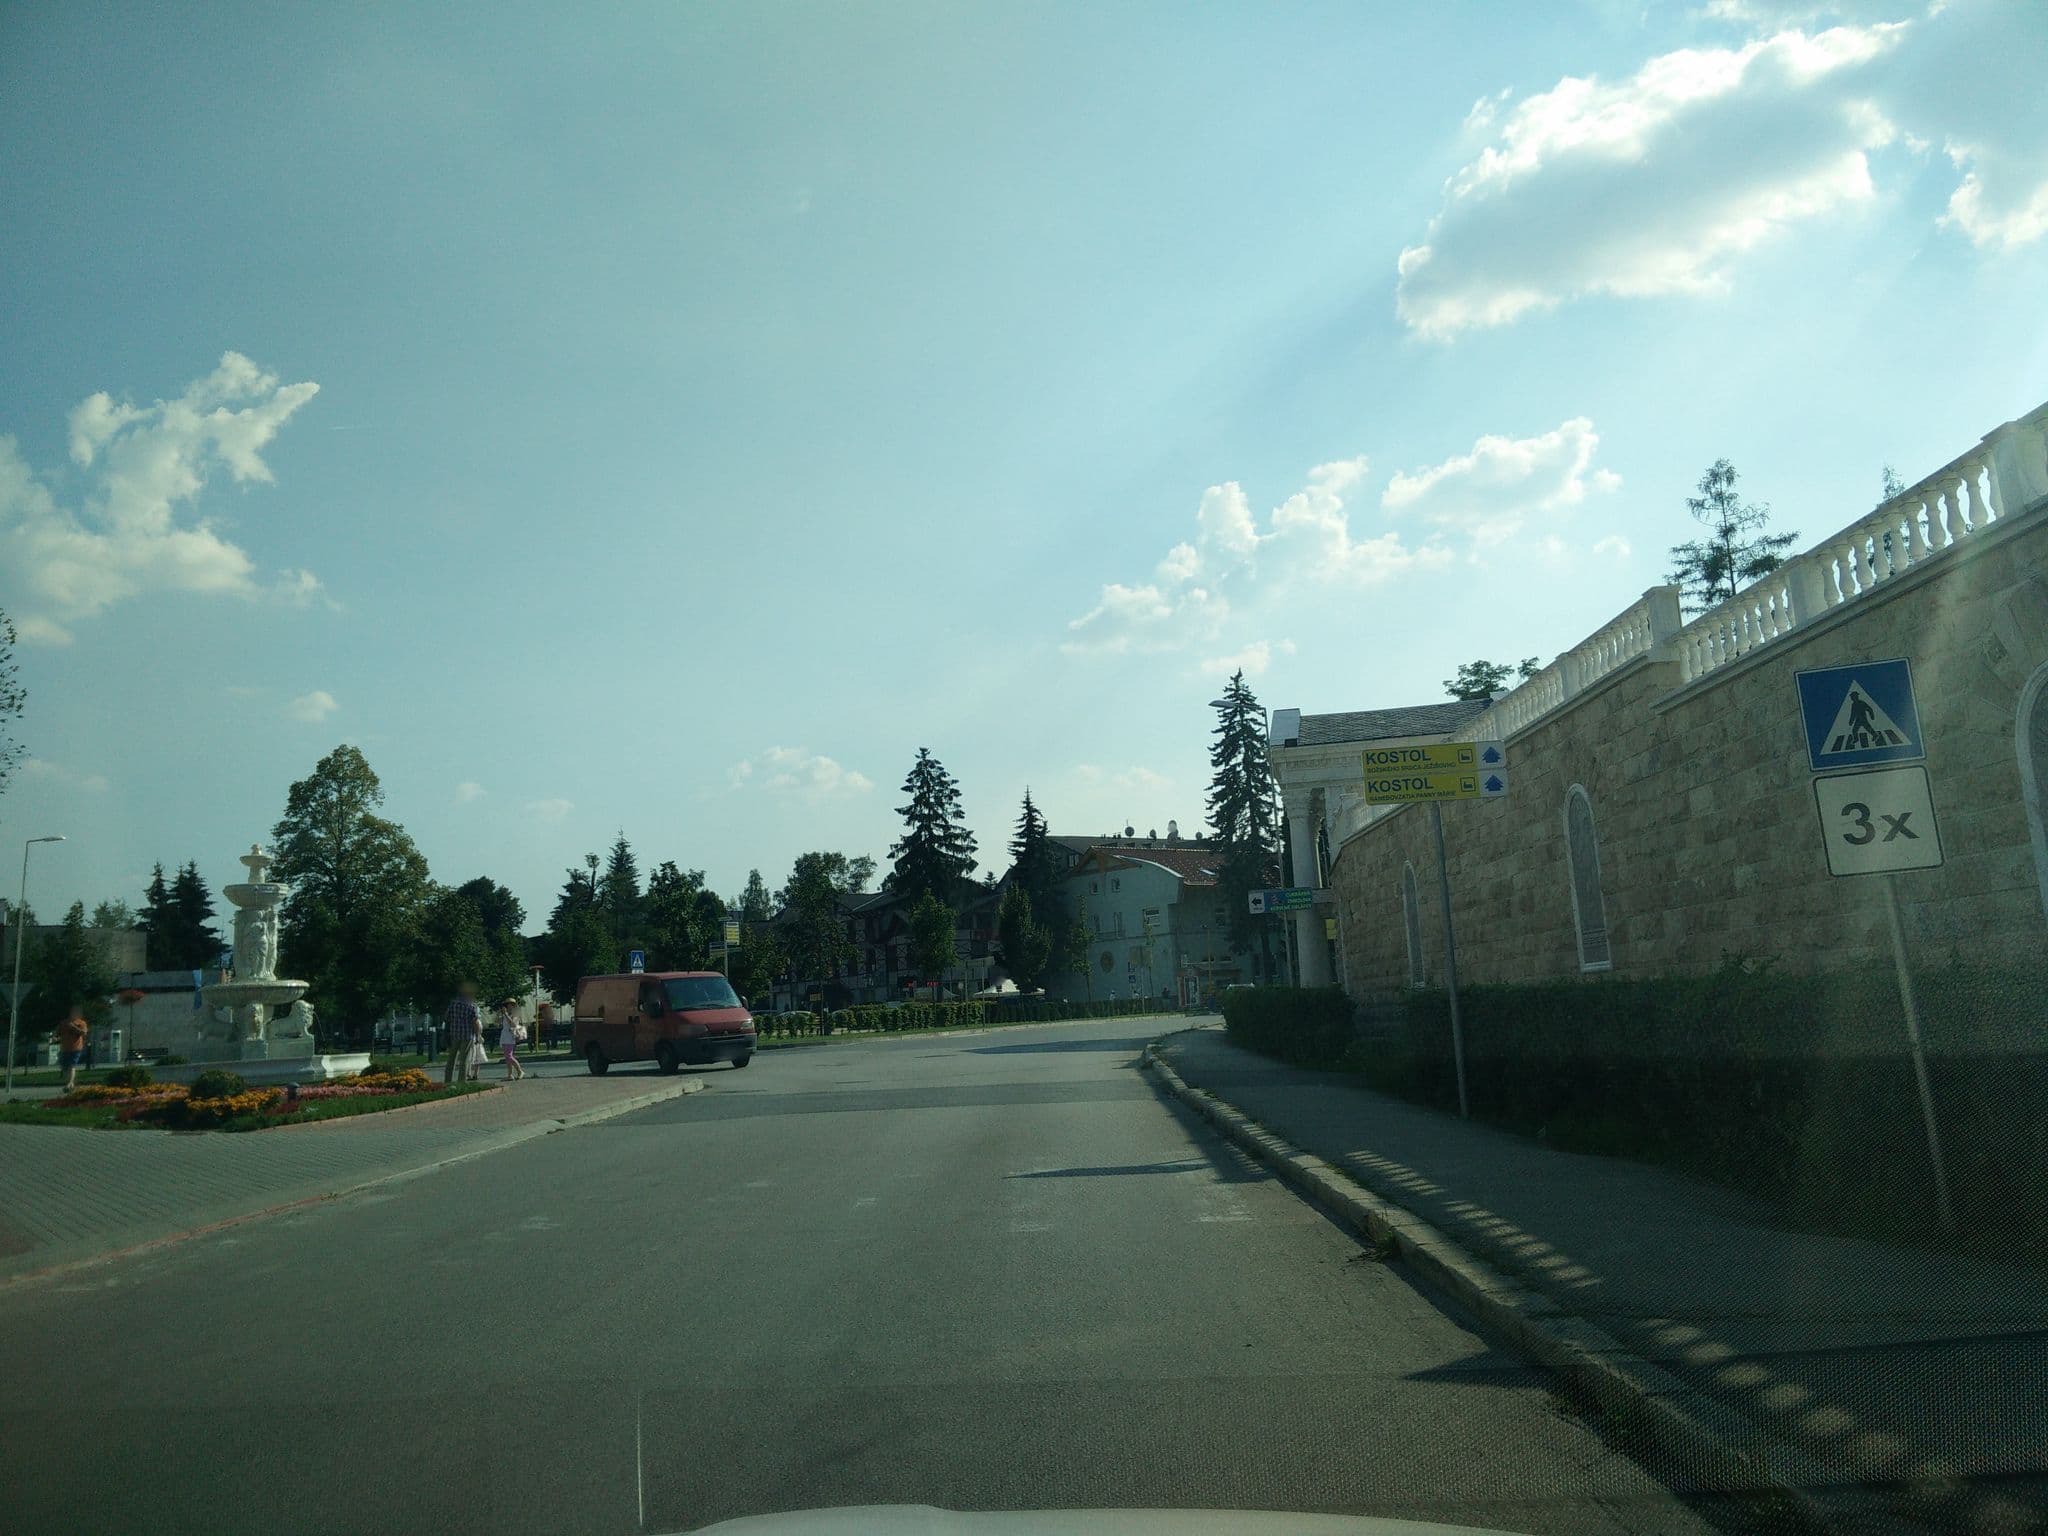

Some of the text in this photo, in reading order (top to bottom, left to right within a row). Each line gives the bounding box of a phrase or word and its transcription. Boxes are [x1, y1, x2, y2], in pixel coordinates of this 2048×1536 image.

[1366, 749, 1431, 764] KOSTOL
[1368, 777, 1433, 793] KOSTOL
[1840, 802, 1920, 846] 3x
